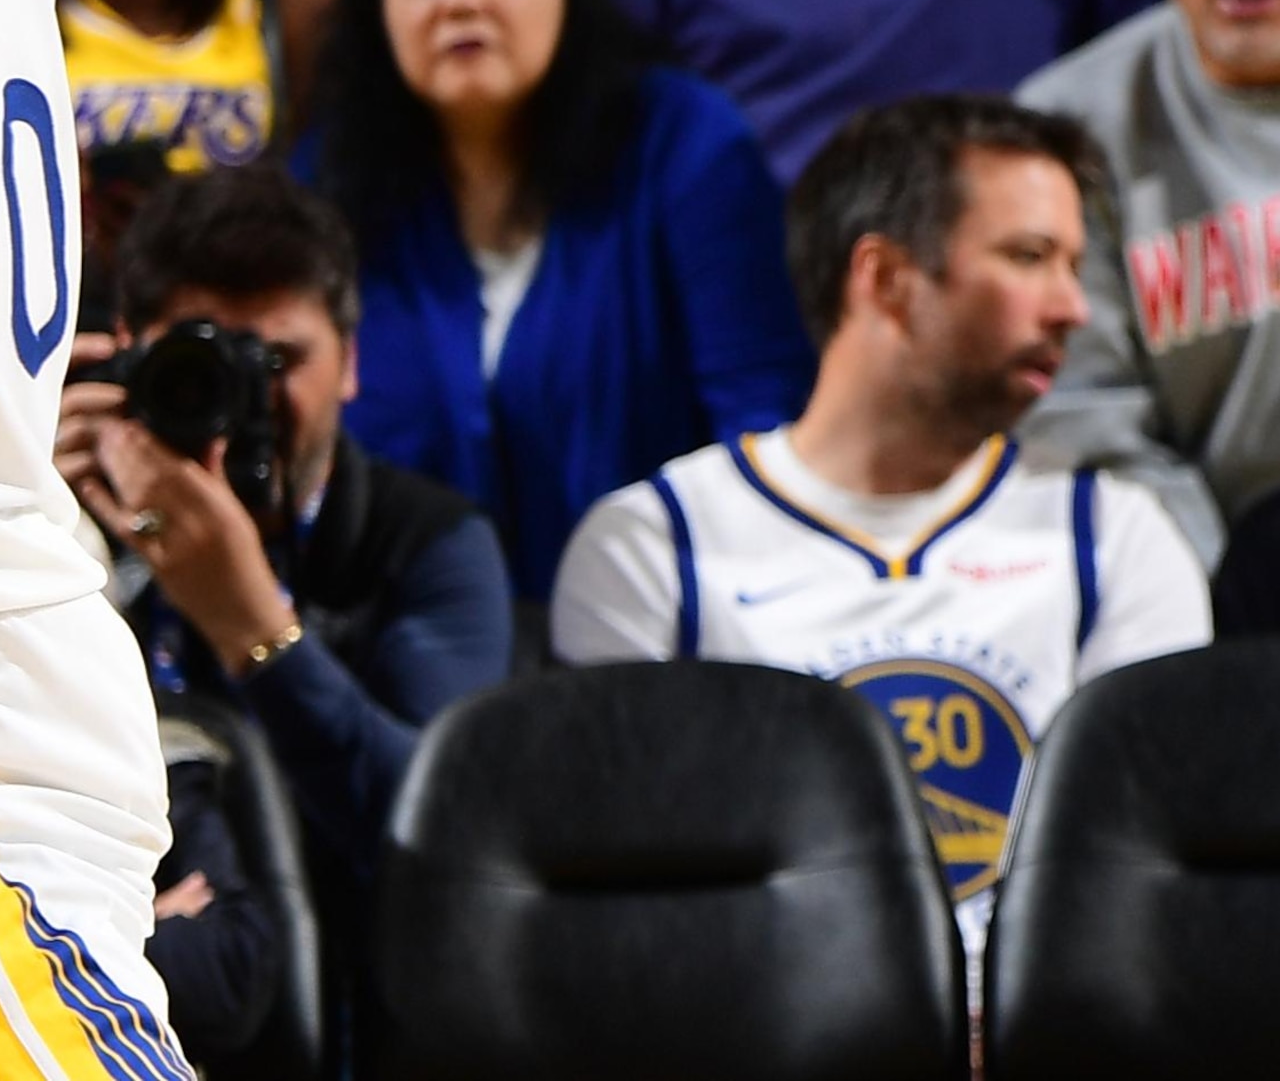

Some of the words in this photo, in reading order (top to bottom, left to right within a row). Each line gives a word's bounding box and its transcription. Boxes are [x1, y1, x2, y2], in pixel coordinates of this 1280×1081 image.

[75, 85, 270, 166] KERS
[2, 77, 69, 379] 0
[892, 693, 984, 774] 30
